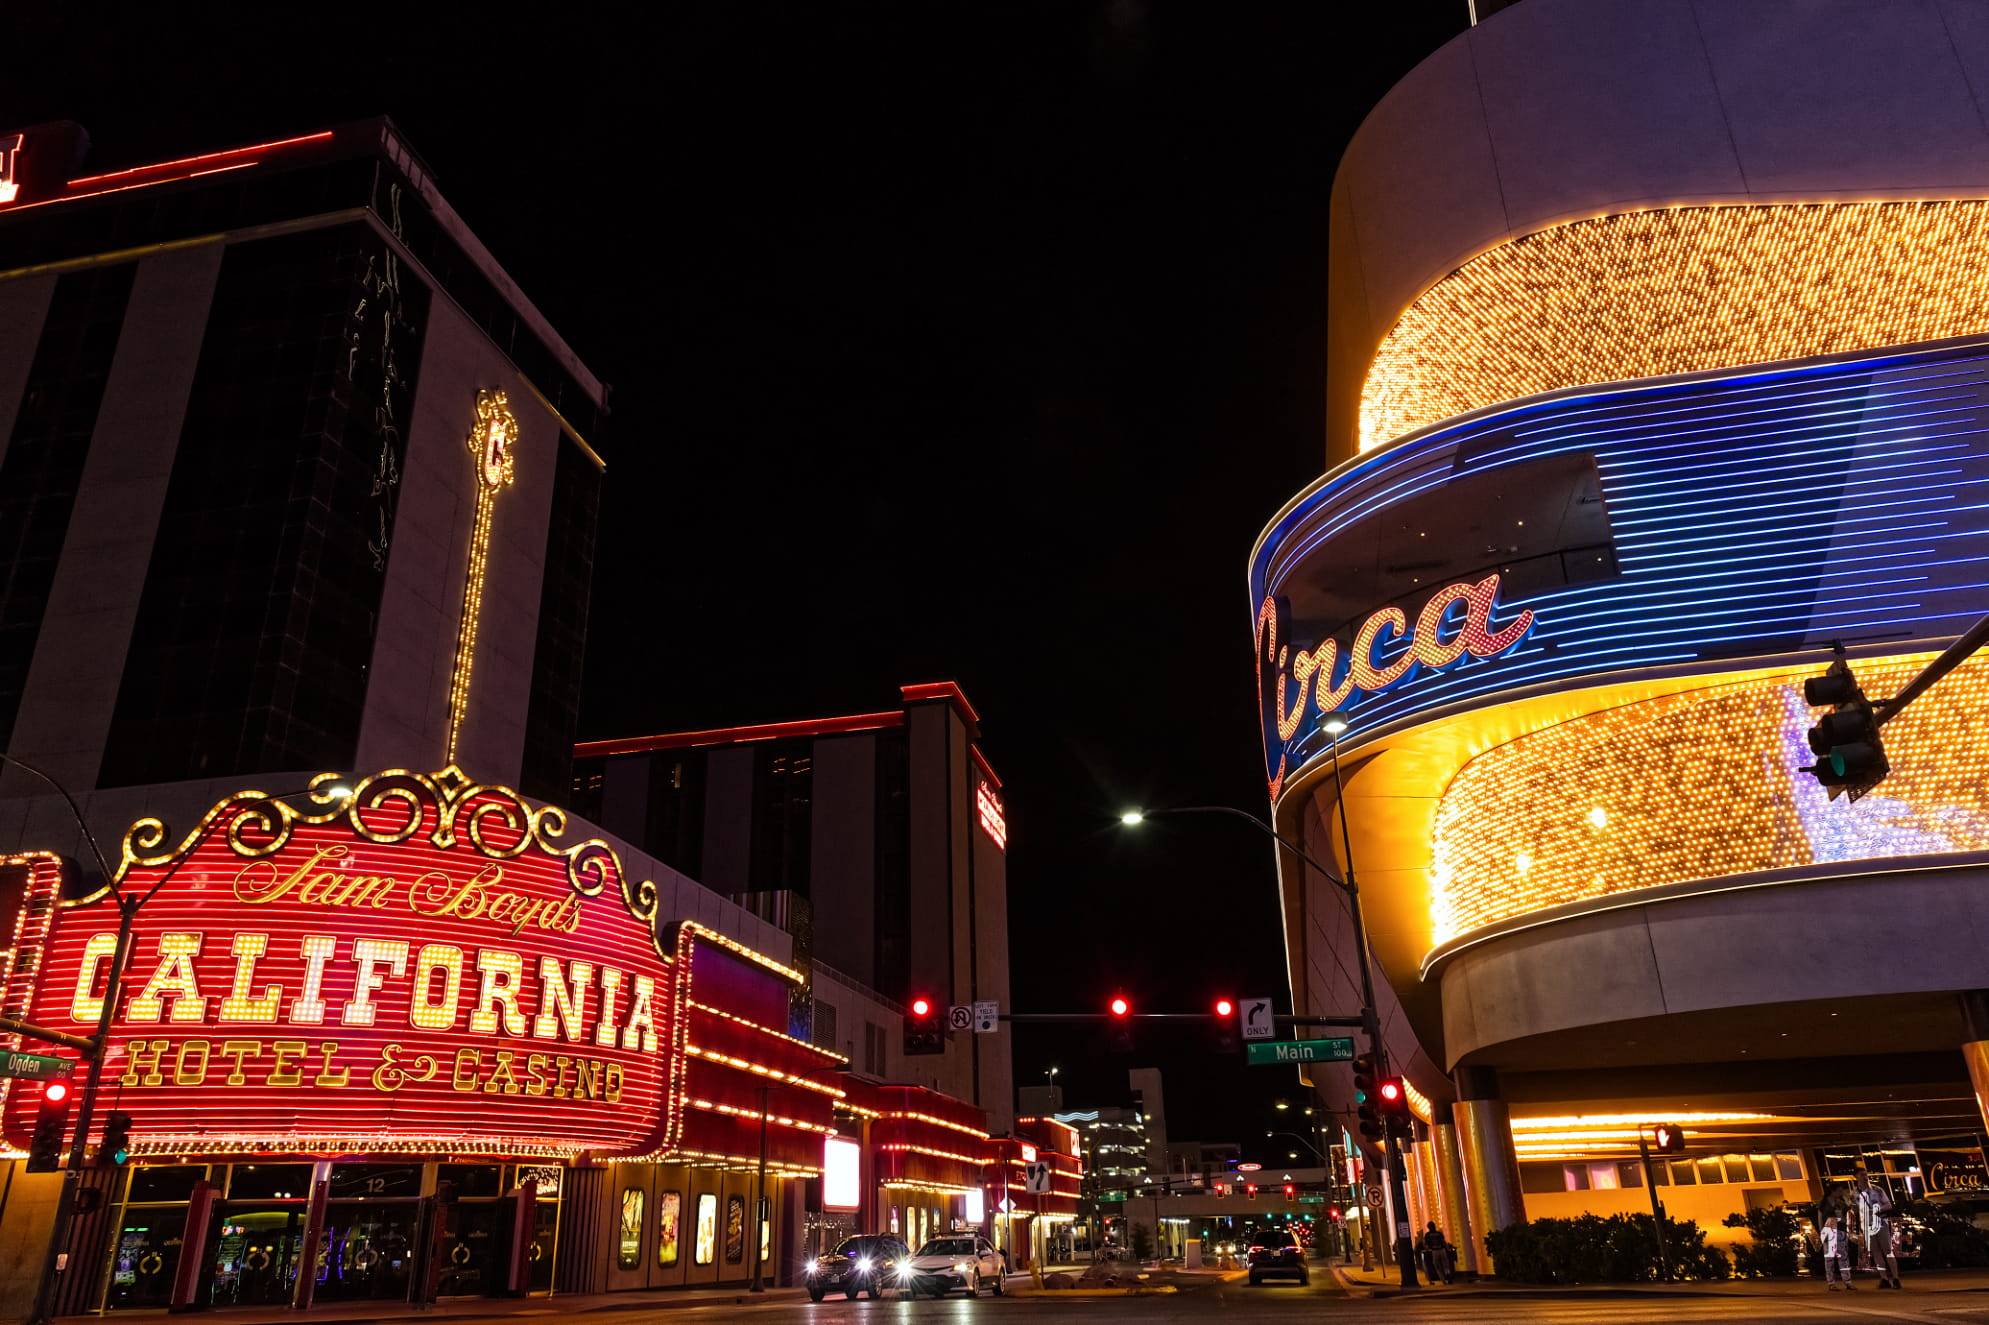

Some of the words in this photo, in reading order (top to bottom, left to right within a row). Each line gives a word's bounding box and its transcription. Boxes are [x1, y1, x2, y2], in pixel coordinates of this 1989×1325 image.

[1256, 573, 1534, 802] Circa
[234, 843, 396, 909] Sam
[408, 862, 582, 937] Boyd's
[70, 931, 659, 1055] CALIFORNIA
[1247, 1026, 1269, 1036] ONLY
[8, 1053, 41, 1076] Ogden
[58, 1062, 73, 1071] AVE
[1276, 1044, 1314, 1061] Main
[1332, 1041, 1341, 1049] ST
[120, 1040, 352, 1087] HOTEL
[372, 1043, 439, 1093] &
[452, 1048, 624, 1103] CASINO
[366, 1178, 386, 1193] 12
[1930, 1162, 1982, 1191] Circa
